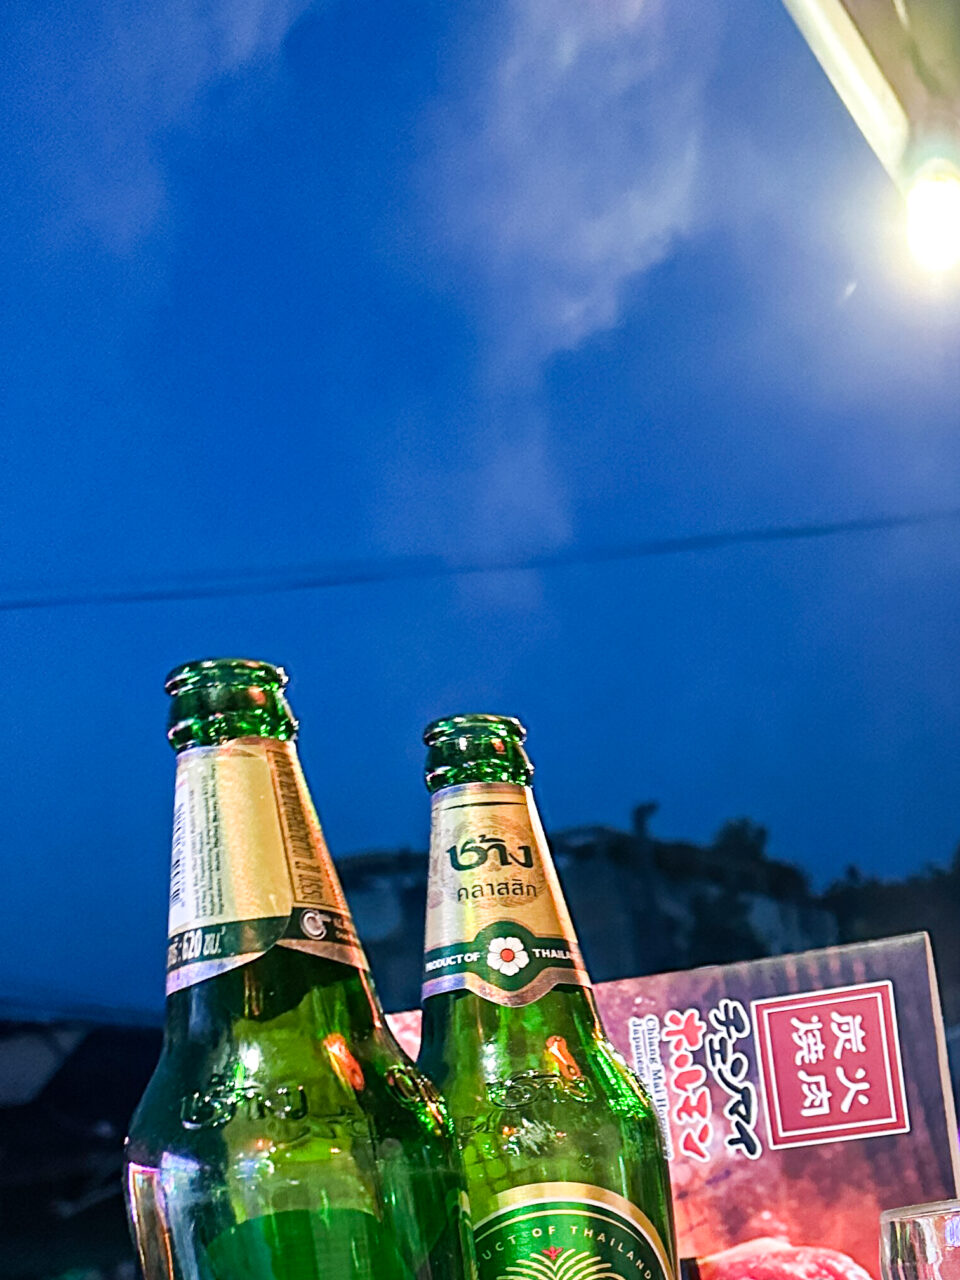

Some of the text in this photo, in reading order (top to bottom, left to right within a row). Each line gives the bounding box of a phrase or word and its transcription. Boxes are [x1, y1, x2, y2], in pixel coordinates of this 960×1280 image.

[446, 833, 534, 871] ช้าง
[457, 879, 537, 902] คลาสสิก
[181, 928, 202, 959] 620
[464, 951, 480, 963] OF
[632, 1020, 646, 1079] Japanese
[646, 1017, 659, 1064] Chiang
[830, 1011, 870, 1113] 炭火
[652, 1068, 664, 1094] Mai
[663, 1010, 711, 1160] ホルモン
[708, 1001, 760, 1158] チェンマイ
[532, 1225, 652, 1280] OF THAILAND
